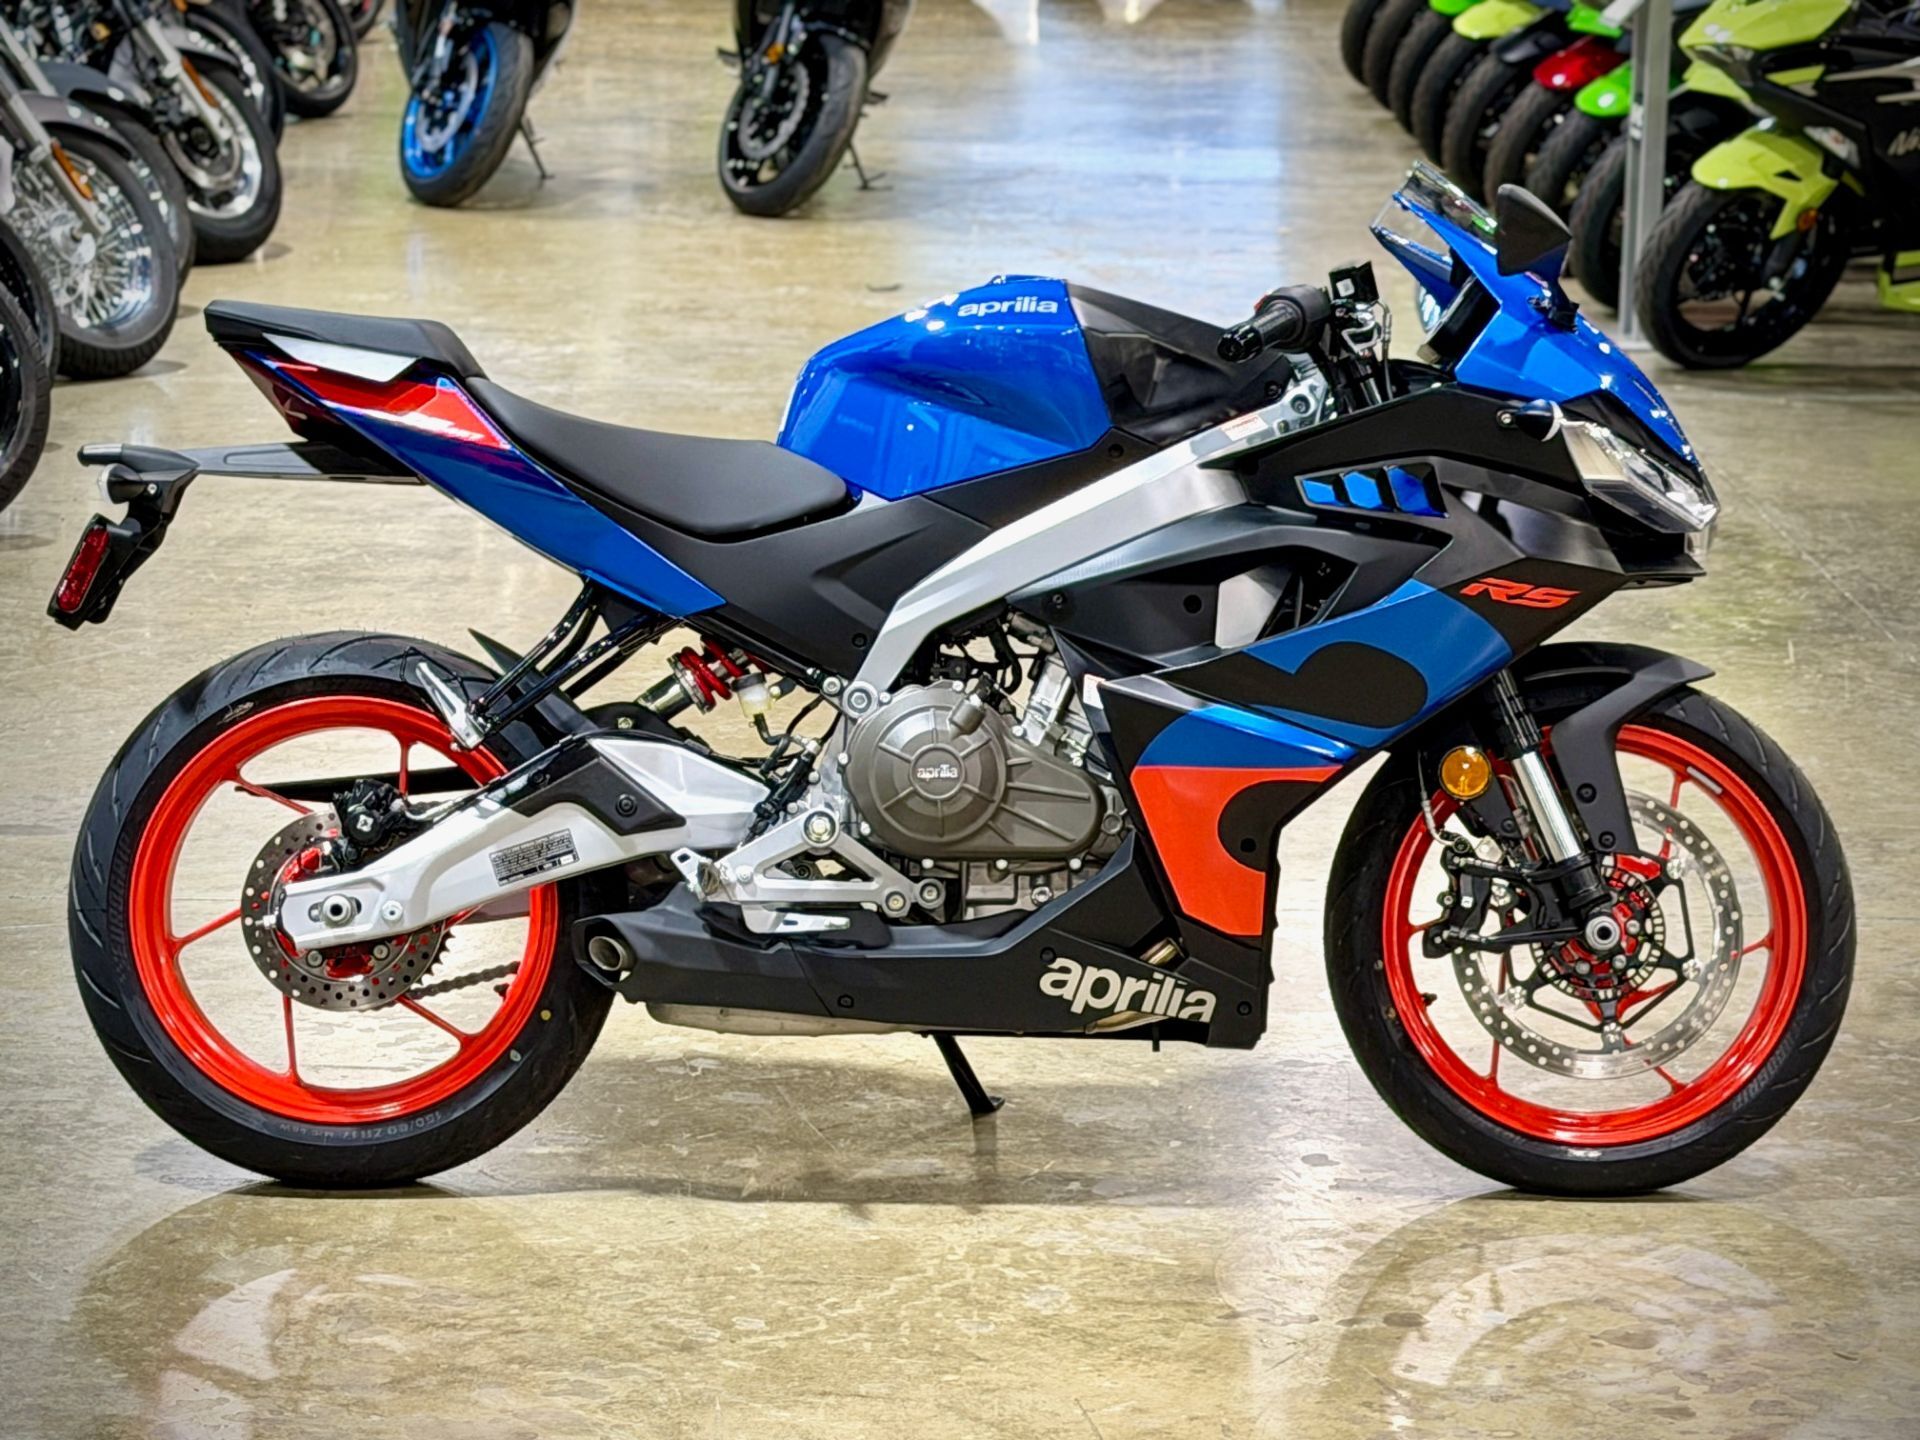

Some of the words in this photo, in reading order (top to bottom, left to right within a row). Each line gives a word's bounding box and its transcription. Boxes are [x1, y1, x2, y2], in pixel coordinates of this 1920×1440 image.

[957, 295, 1059, 317] aprilia
[1460, 577, 1581, 609] RS
[916, 763, 958, 782] aprilia
[1039, 957, 1217, 1023] aprilia
